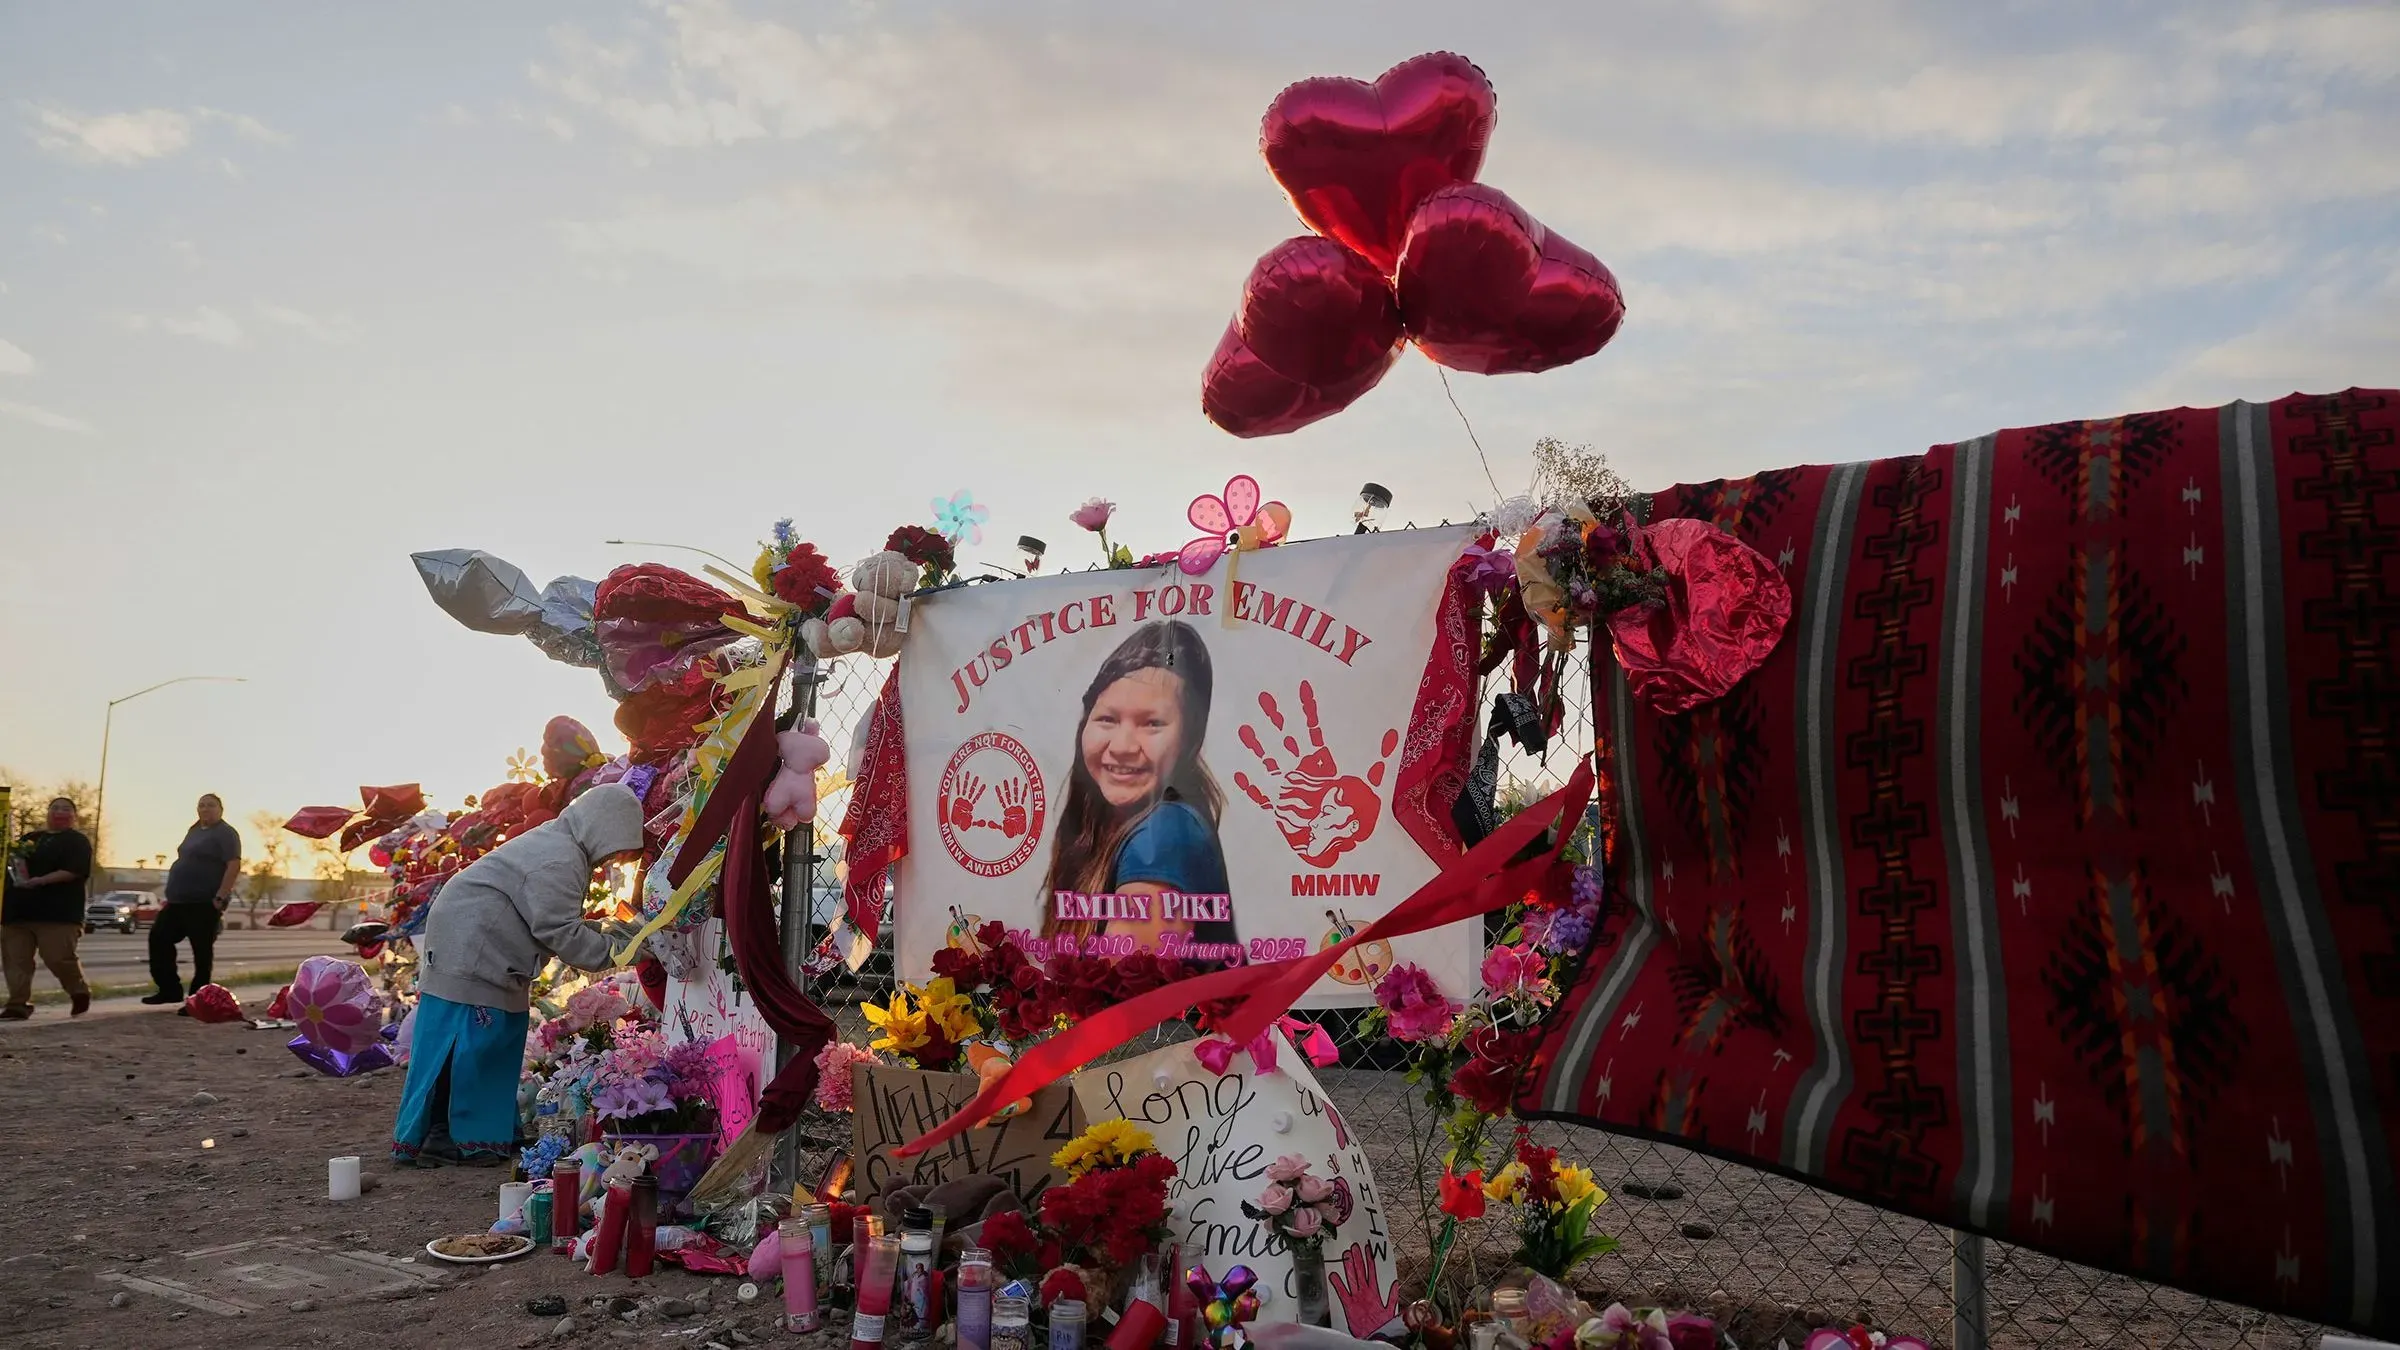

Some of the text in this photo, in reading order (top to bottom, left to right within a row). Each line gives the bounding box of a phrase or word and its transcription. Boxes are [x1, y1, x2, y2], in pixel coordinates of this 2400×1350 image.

[950, 580, 1373, 714] JUSTICE FOR EMILY
[940, 733, 1044, 812] YOU ARE NOT FORGOTTEN
[941, 822, 1037, 876] MMIW AWARENESS
[1055, 890, 1231, 922] EMILY PIKE
[1292, 874, 1380, 896] MMIW
[1008, 929, 1049, 962] May
[1055, 932, 1080, 956] 16,
[1087, 933, 1134, 955] 2010
[1158, 930, 1244, 967] February
[1250, 937, 1307, 961] 2025
[1104, 1071, 1256, 1149] Long
[1171, 1125, 1275, 1199] Live
